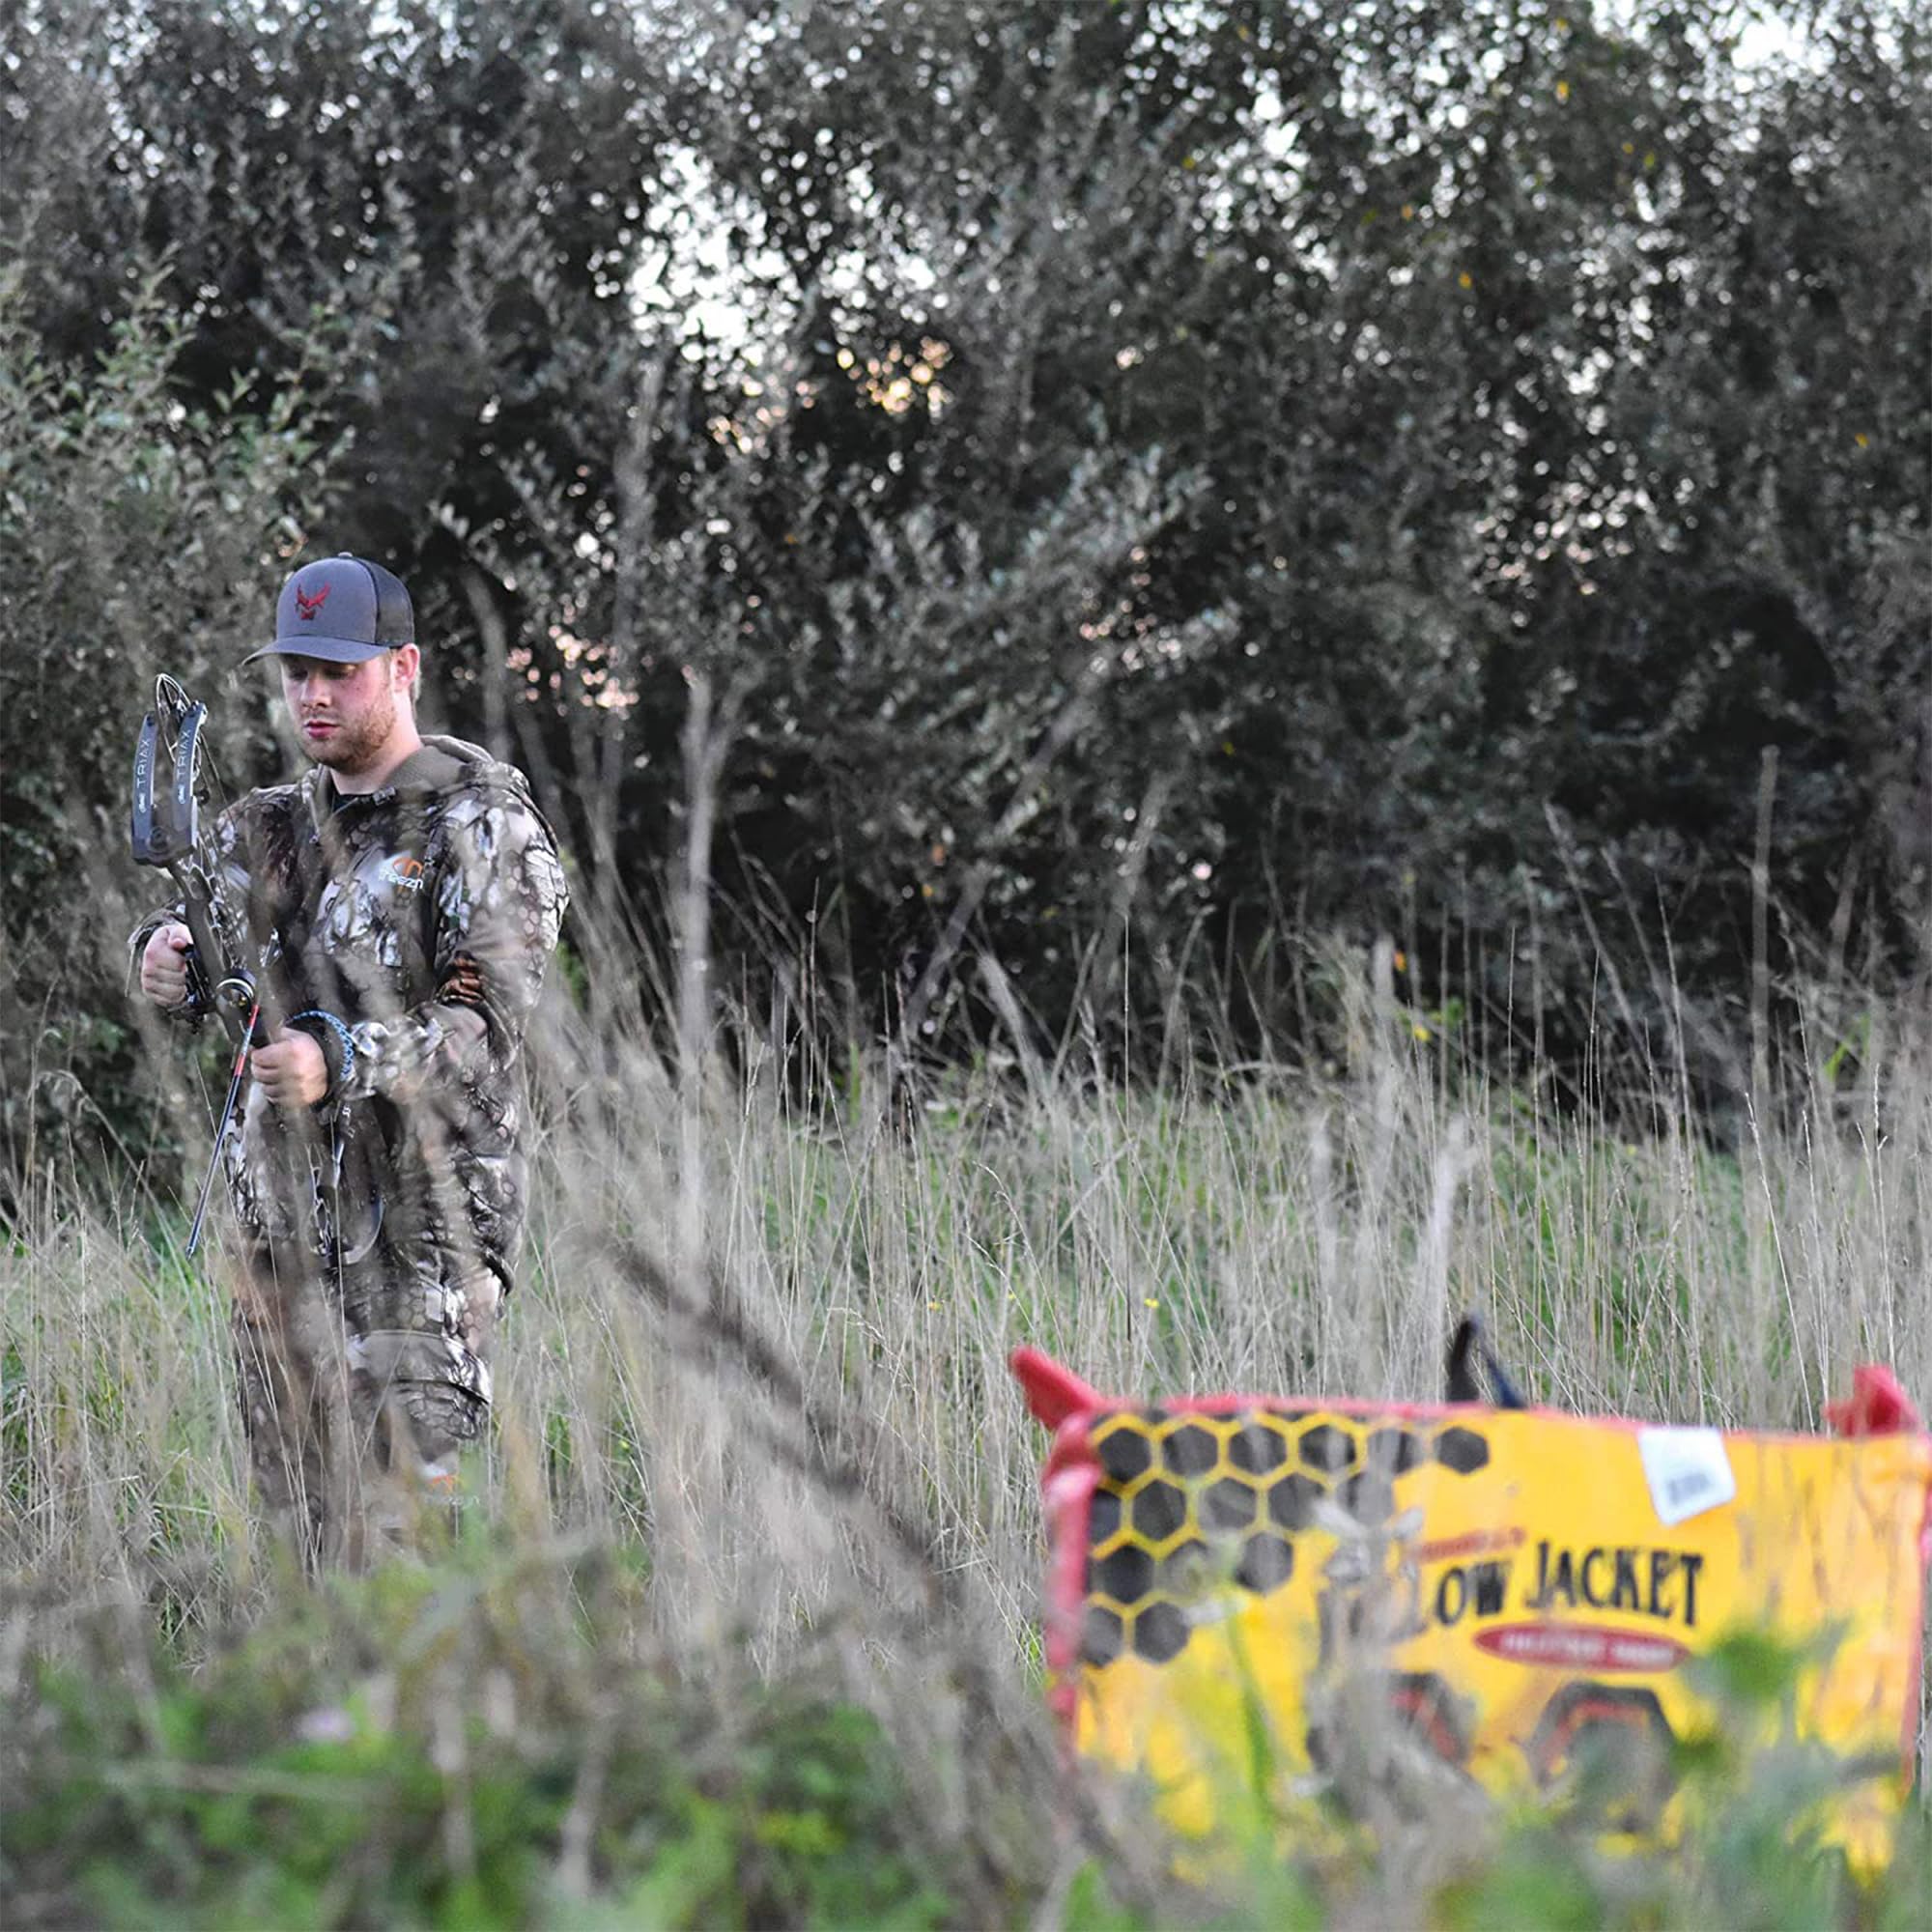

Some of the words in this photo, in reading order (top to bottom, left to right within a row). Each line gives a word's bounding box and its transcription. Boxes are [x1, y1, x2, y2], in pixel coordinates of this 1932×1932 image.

[136, 737, 151, 789] TRIAX
[176, 728, 191, 781] TRIAX
[1523, 1541, 1703, 1627] JACKET
